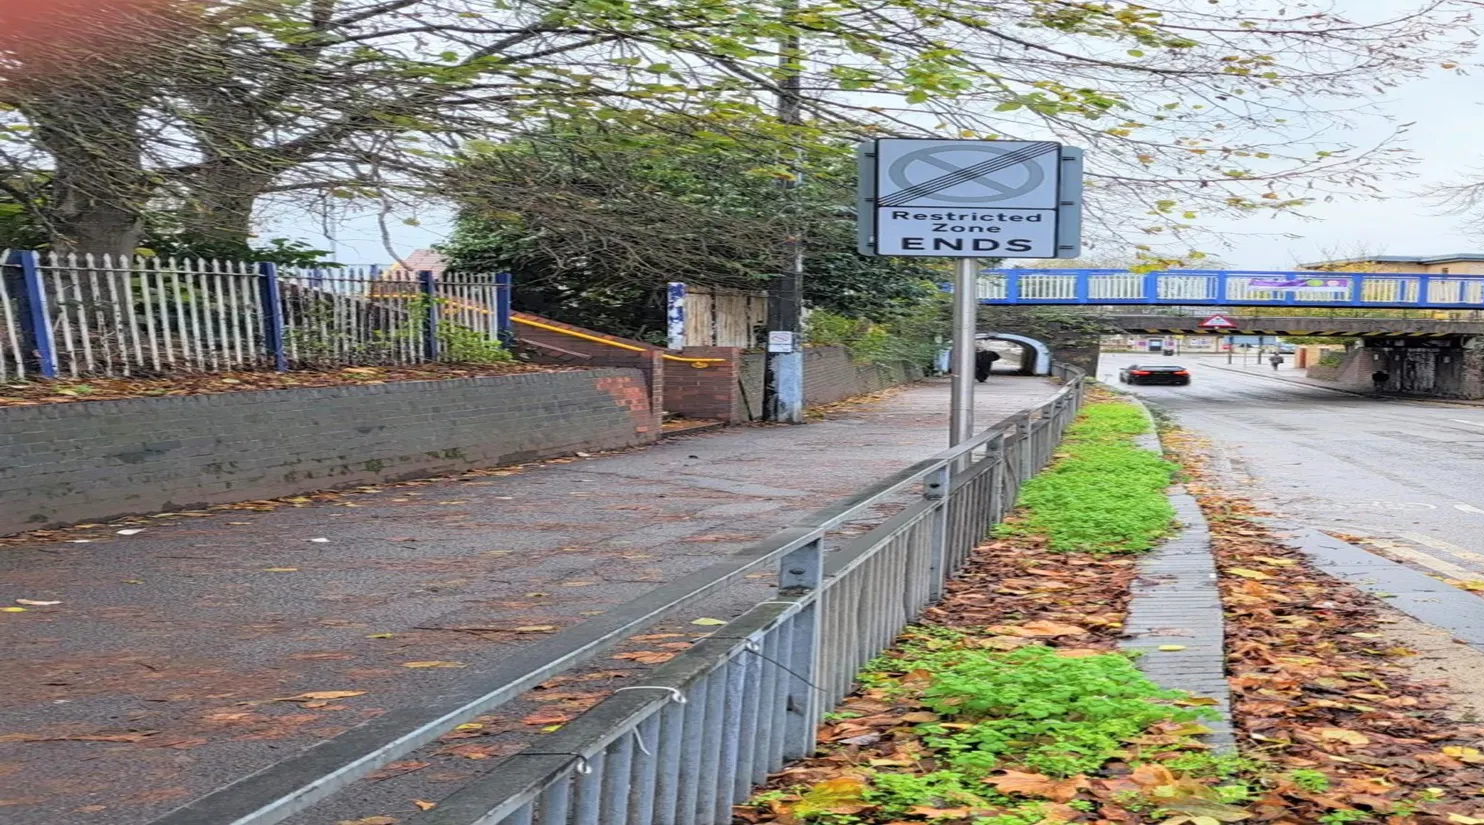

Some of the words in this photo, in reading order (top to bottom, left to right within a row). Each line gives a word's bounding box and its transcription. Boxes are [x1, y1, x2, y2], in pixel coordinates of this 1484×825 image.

[892, 210, 1041, 222] Restricted
[932, 223, 1001, 233] Zone
[902, 237, 1032, 252] ENDS
